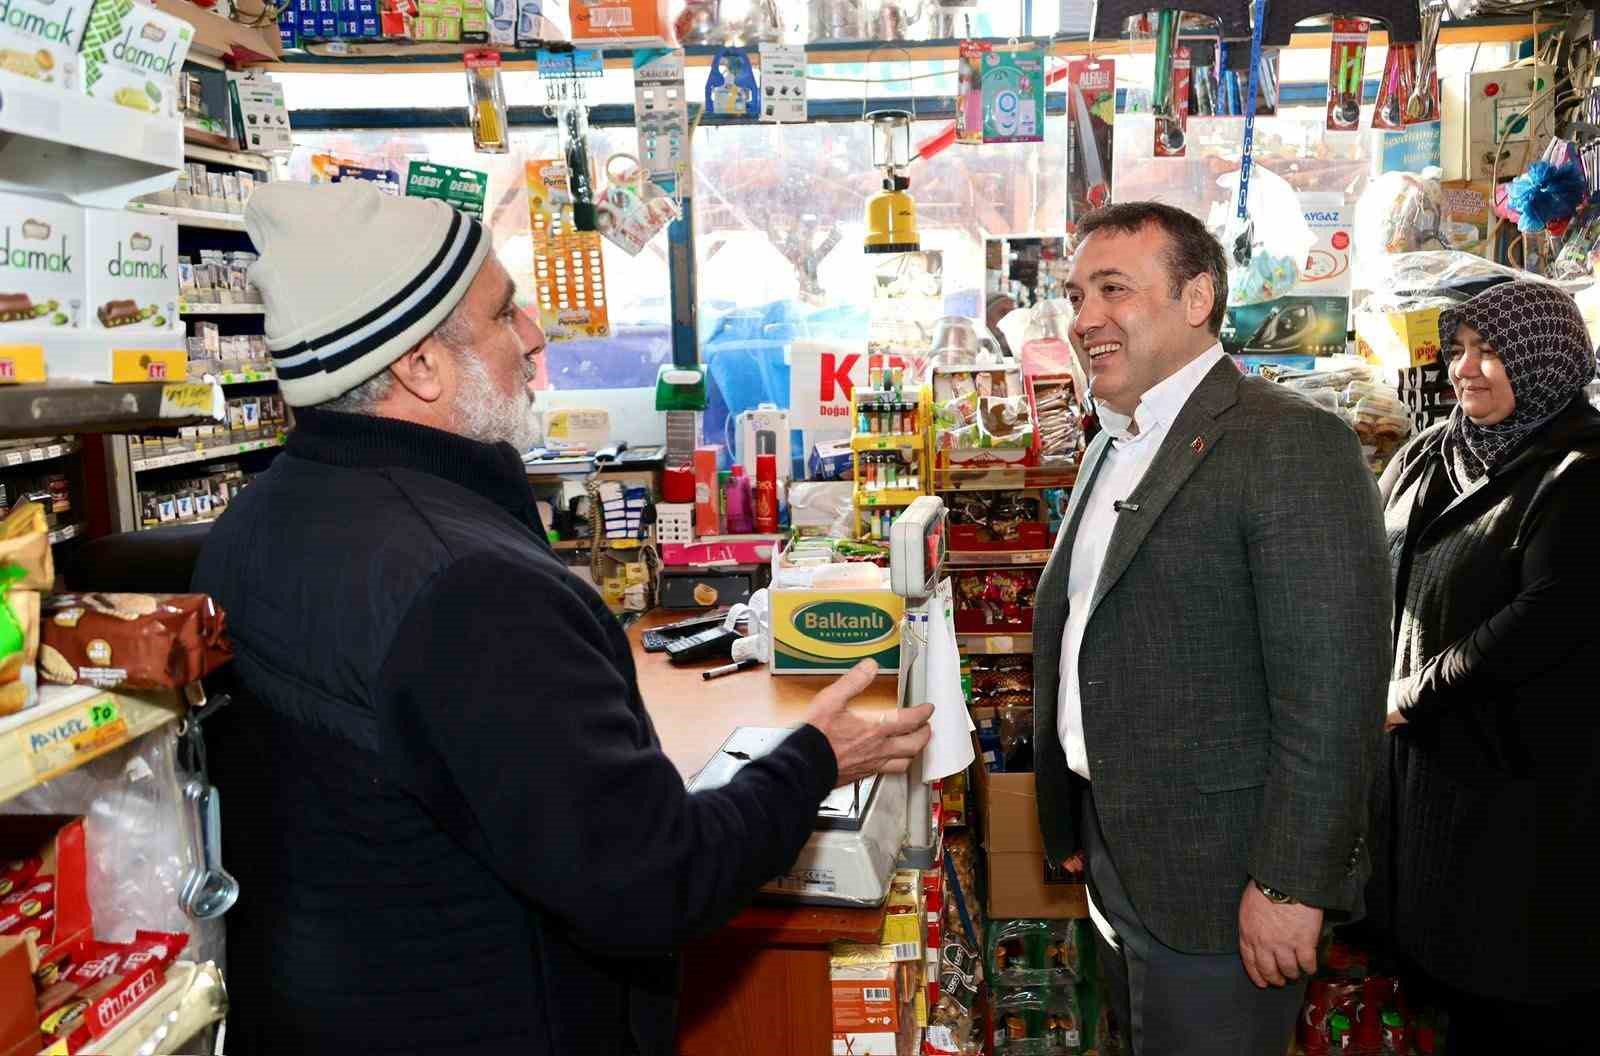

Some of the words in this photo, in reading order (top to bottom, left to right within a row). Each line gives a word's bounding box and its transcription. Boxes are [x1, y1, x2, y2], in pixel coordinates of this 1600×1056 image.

[112, 26, 177, 76] damak
[410, 174, 444, 190] DERBY
[448, 179, 481, 195] DERBY
[108, 241, 169, 280] damak
[804, 611, 885, 630] Balkanlı
[91, 705, 112, 722] 50
[97, 967, 158, 1028] ÜLKER
